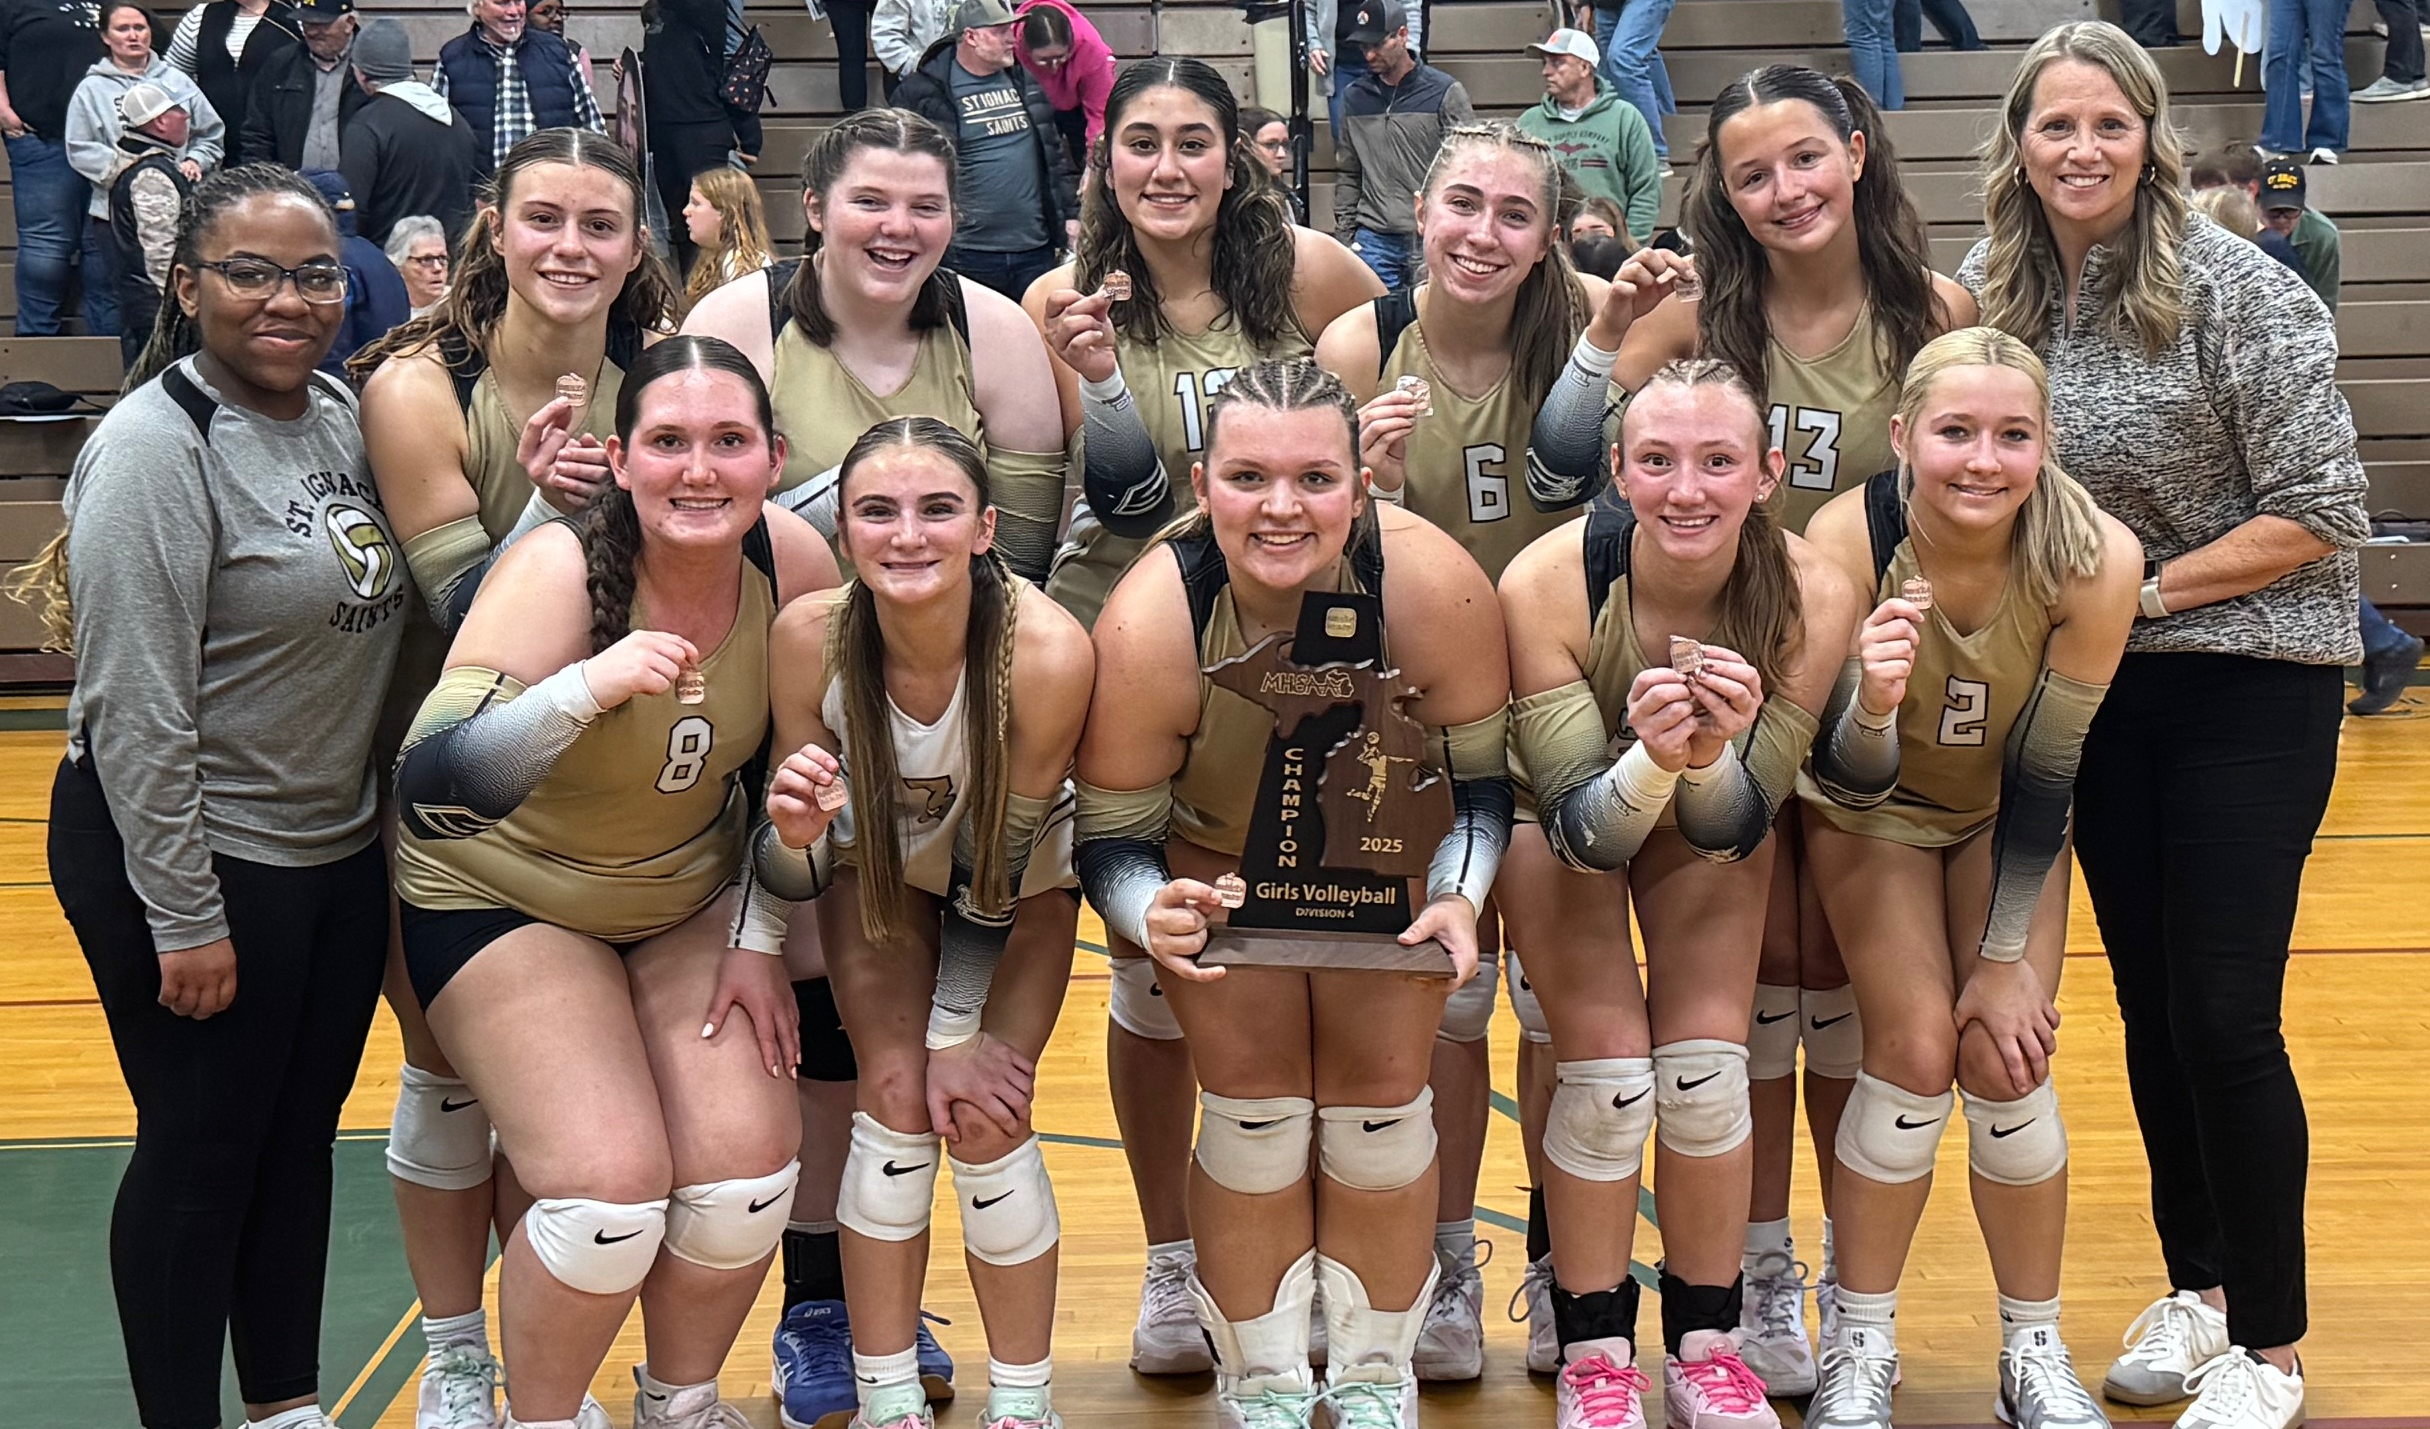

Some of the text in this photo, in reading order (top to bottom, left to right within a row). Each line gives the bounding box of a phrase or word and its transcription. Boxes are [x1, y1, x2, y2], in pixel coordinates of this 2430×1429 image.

[962, 93, 980, 112] ST
[1767, 403, 1842, 492] 13
[1463, 441, 1511, 523] 6
[285, 499, 315, 539] ST.
[328, 583, 404, 634] SAINTS
[1937, 673, 1989, 747] 2
[654, 715, 714, 795] 8
[1277, 747, 1304, 868] CHAMPION
[1359, 836, 1403, 853] 2025
[1255, 881, 1300, 901] Girls
[1302, 883, 1396, 907] Volleyball
[1294, 907, 1355, 919] DIVISION 4
